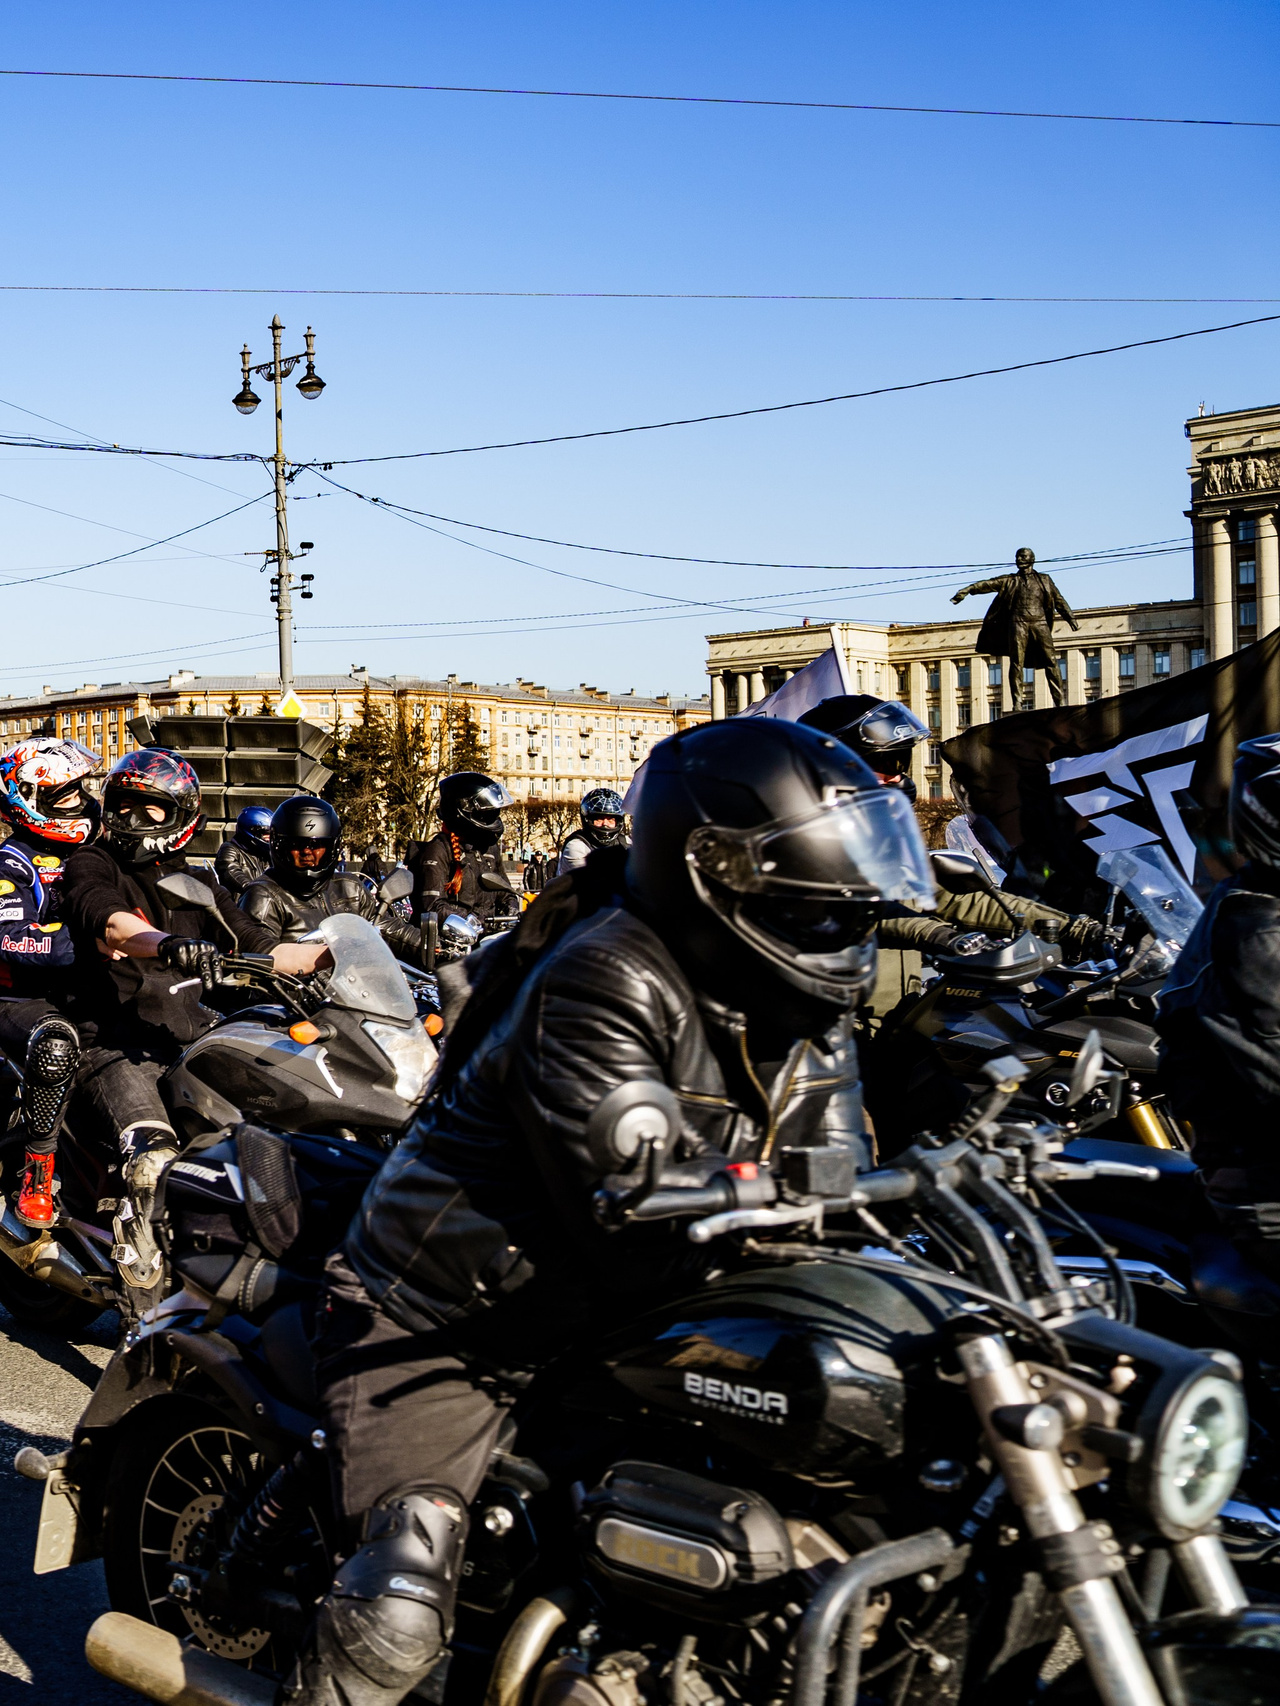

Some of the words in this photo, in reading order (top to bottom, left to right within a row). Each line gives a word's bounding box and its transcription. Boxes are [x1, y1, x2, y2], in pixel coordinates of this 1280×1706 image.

[946, 987, 983, 999] VOGE
[247, 1096, 278, 1108] HONDA
[684, 1372, 788, 1415] BENDA
[613, 1532, 701, 1578] ROCK
